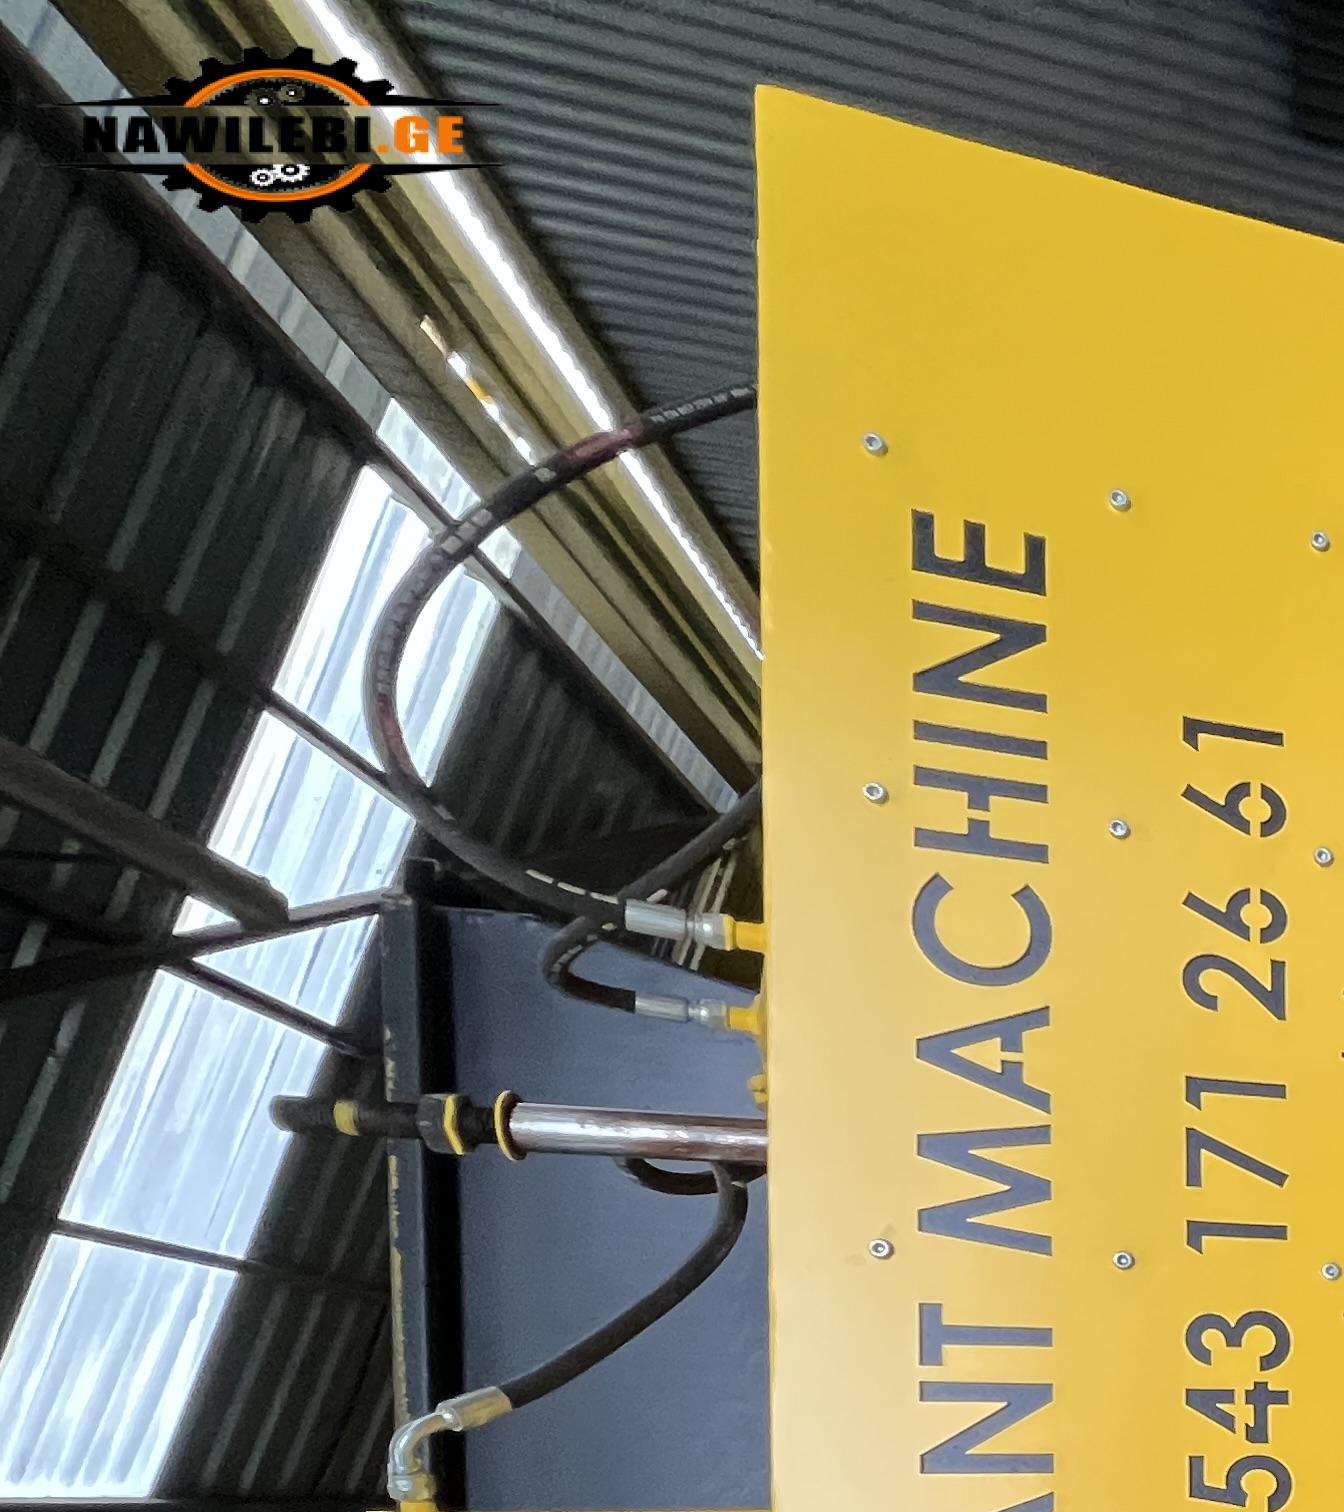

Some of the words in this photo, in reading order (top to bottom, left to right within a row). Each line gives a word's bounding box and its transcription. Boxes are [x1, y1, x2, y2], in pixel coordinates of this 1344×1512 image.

[1181, 716, 1287, 838] 61
[911, 509, 1053, 1257] MACHINE
[1181, 888, 1287, 1021] 26
[1184, 1076, 1289, 1254] 171
